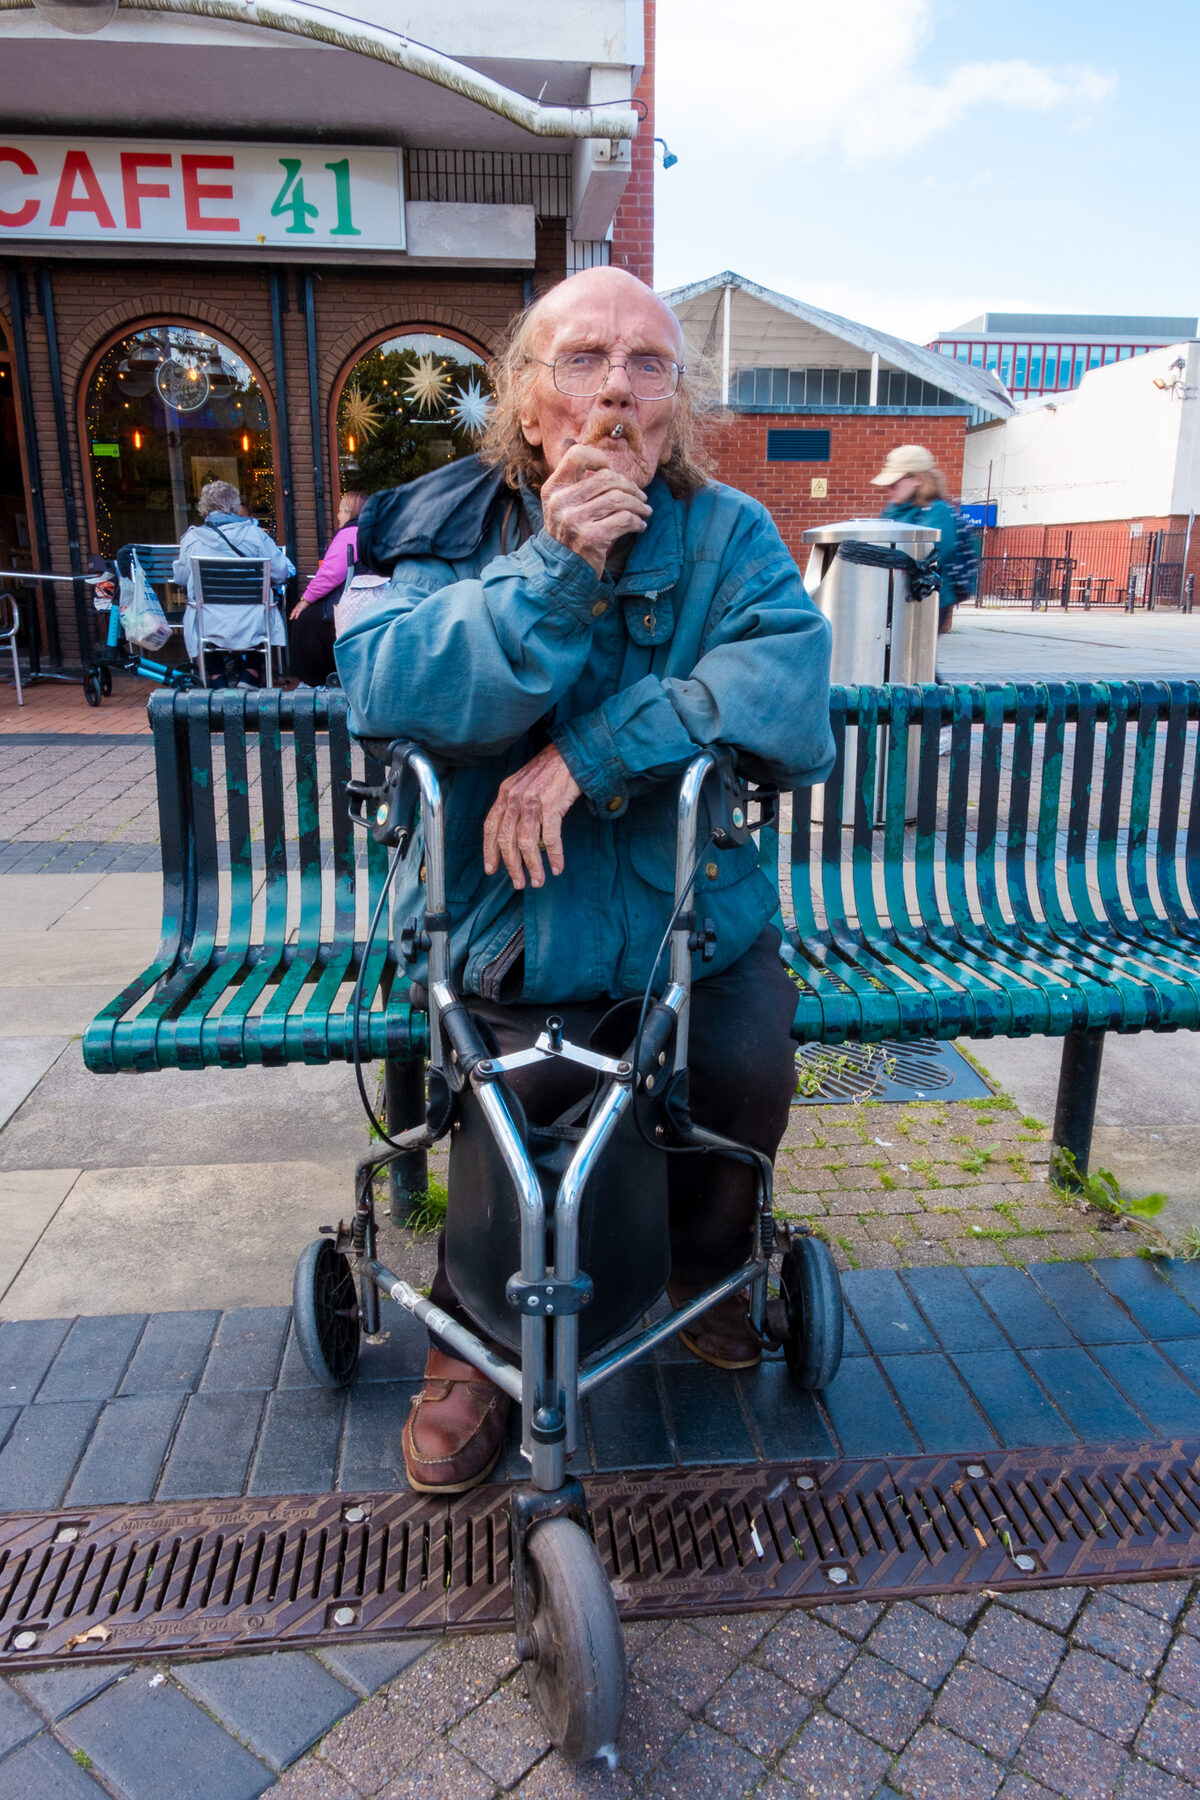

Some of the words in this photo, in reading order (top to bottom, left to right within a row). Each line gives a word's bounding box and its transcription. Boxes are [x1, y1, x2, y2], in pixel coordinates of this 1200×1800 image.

[0, 146, 241, 232] CAFE
[270, 157, 362, 235] 41
[282, 1509, 310, 1519] 250
